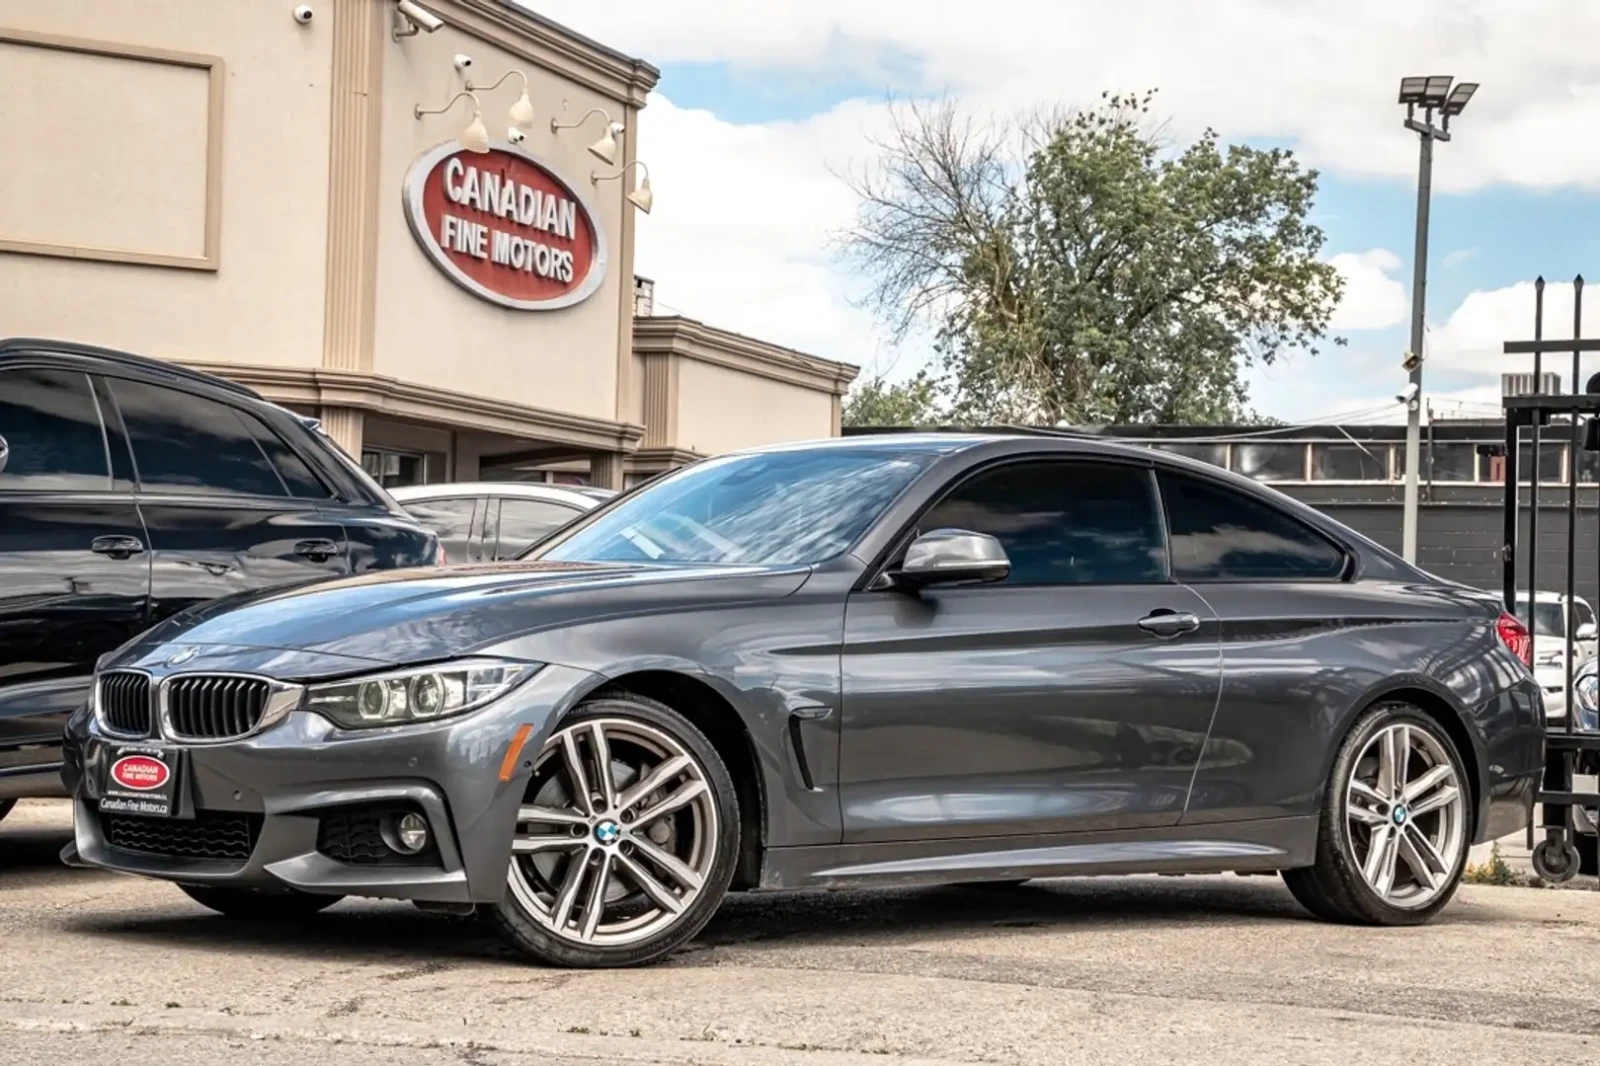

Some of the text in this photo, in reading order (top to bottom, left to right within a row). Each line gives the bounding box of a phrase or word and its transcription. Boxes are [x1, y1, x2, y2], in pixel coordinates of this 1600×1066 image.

[445, 157, 576, 240] CANADIAN
[441, 214, 574, 283] FINE MOTORS
[101, 798, 127, 810] Canadian
[128, 799, 139, 811] Fine
